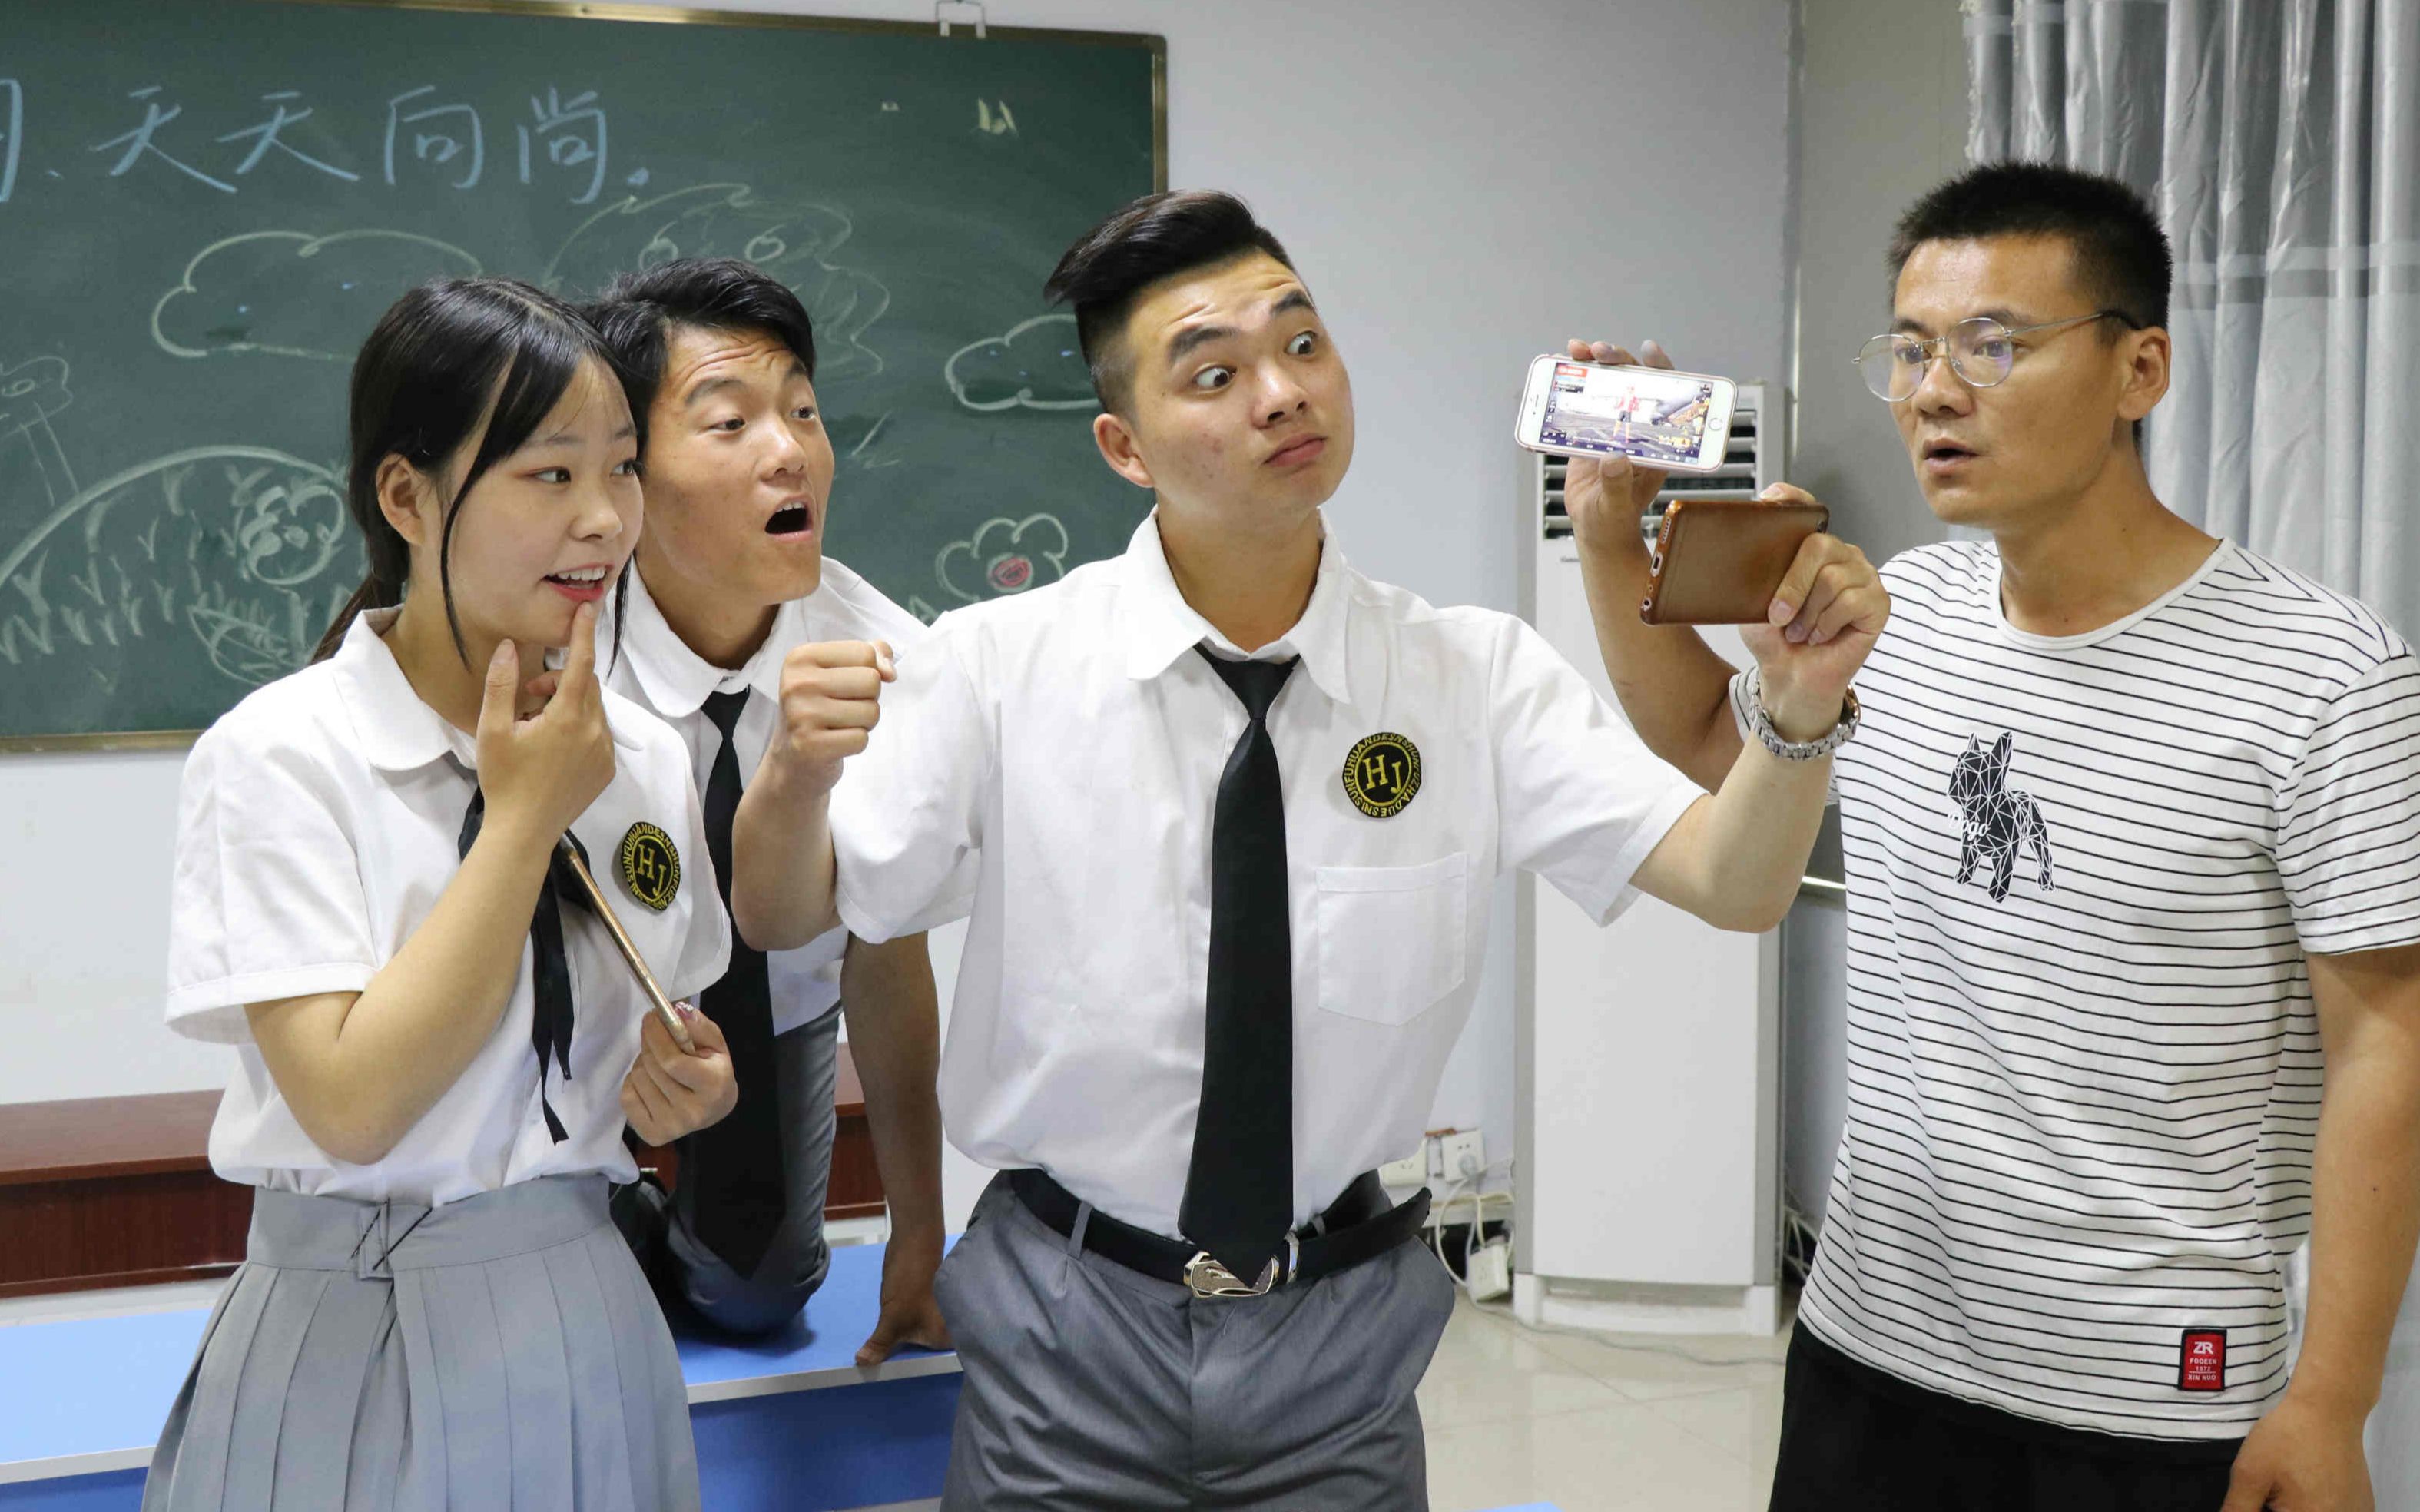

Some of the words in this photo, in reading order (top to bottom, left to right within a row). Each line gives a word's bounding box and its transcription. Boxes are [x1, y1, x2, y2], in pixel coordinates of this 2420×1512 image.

[1363, 754, 1401, 794] HJ
[1948, 812, 1989, 841] Dogo
[636, 844, 666, 897] HJ
